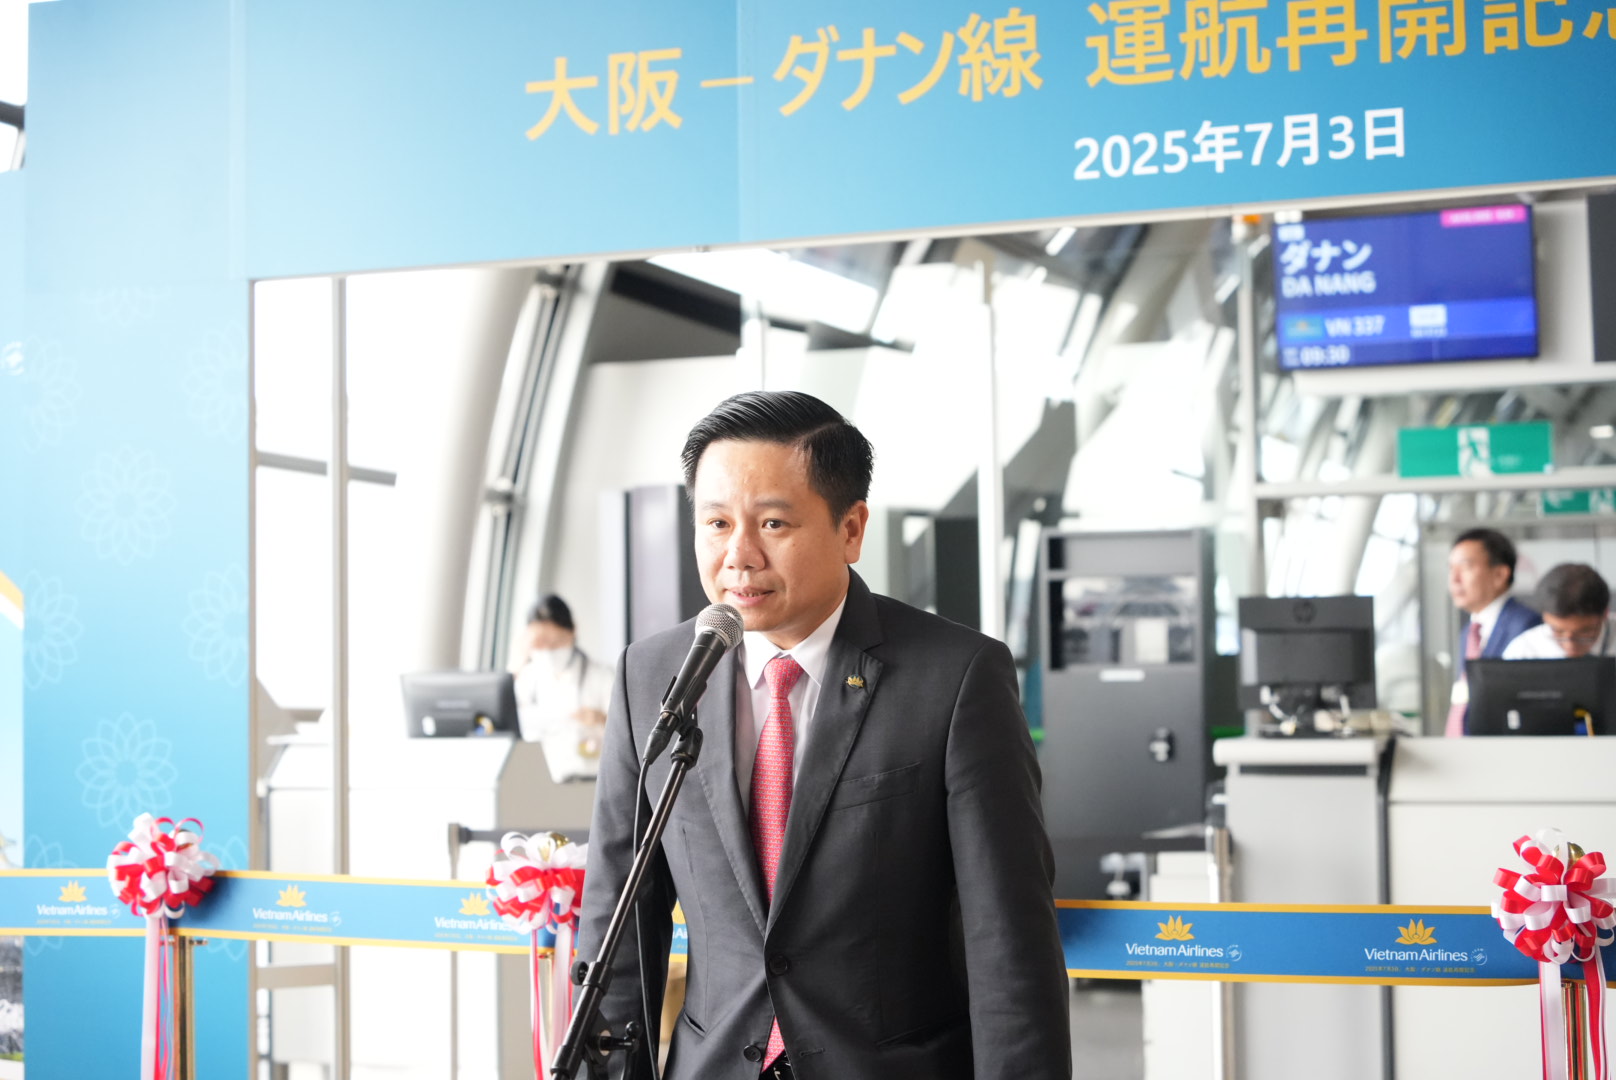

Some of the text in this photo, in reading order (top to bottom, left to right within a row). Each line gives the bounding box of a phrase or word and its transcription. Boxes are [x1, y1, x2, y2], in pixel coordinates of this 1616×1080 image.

[1086, 0, 1616, 88] 運航再開記
[1073, 107, 1405, 180] 2025年7月3日
[1280, 239, 1372, 275] ダナン
[1282, 270, 1377, 298] DA NANG
[1125, 943, 1177, 956] Vietnam
[1177, 944, 1224, 958] Airlines
[1364, 948, 1419, 961] Vietnam
[1419, 948, 1468, 962] Airlines
